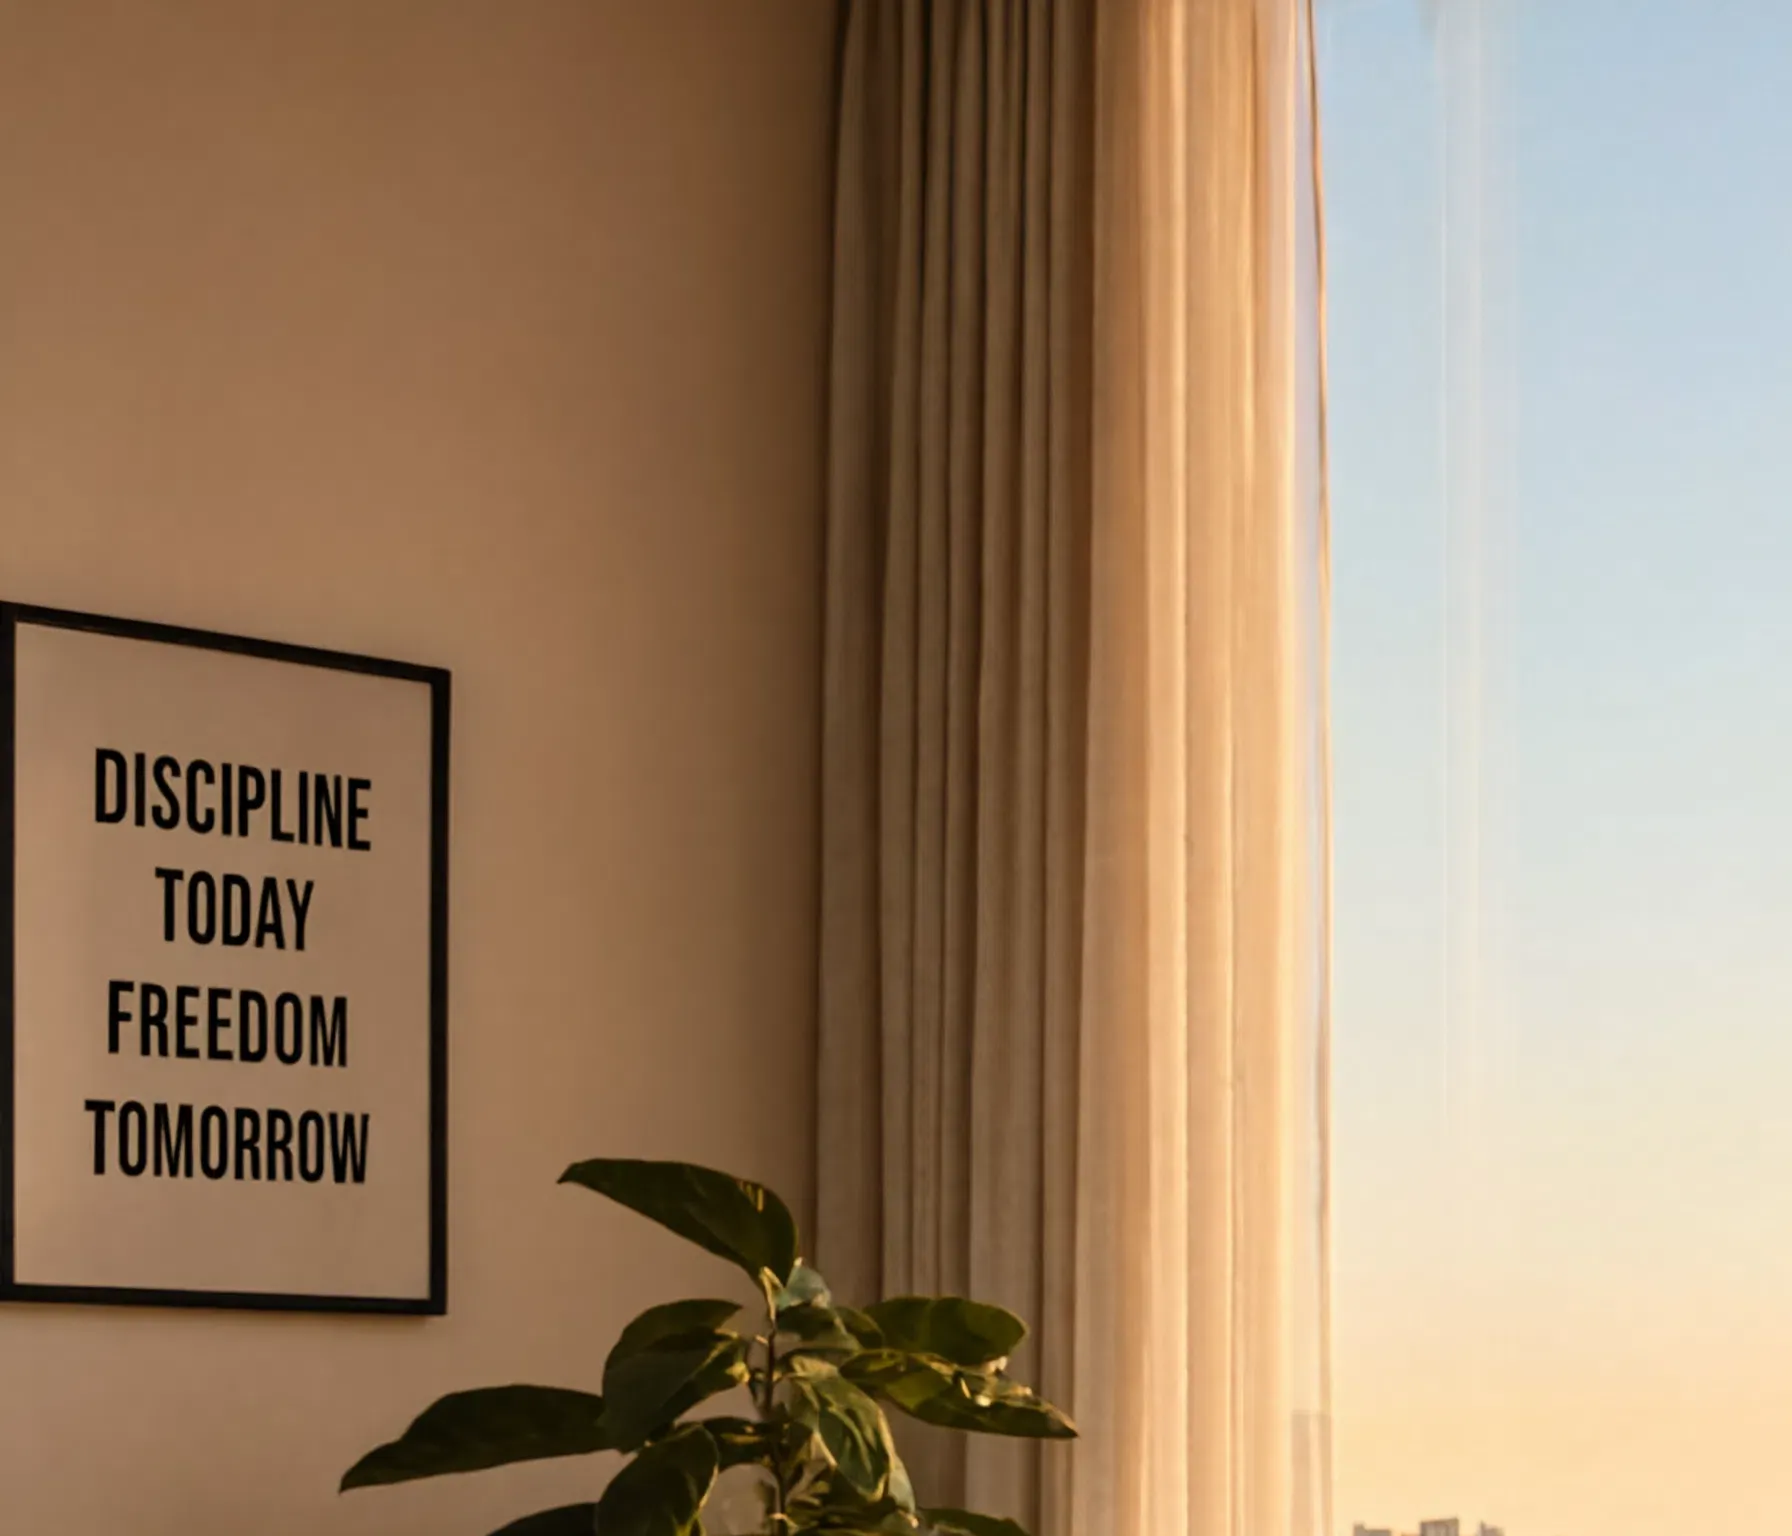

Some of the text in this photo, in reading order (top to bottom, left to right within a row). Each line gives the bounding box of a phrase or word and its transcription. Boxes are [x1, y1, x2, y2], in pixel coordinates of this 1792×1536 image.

[96, 748, 371, 851] DISCIPLINE
[155, 867, 314, 951] TODAY
[109, 981, 347, 1067] FREEDOM
[85, 1100, 369, 1183] TOMORROW
